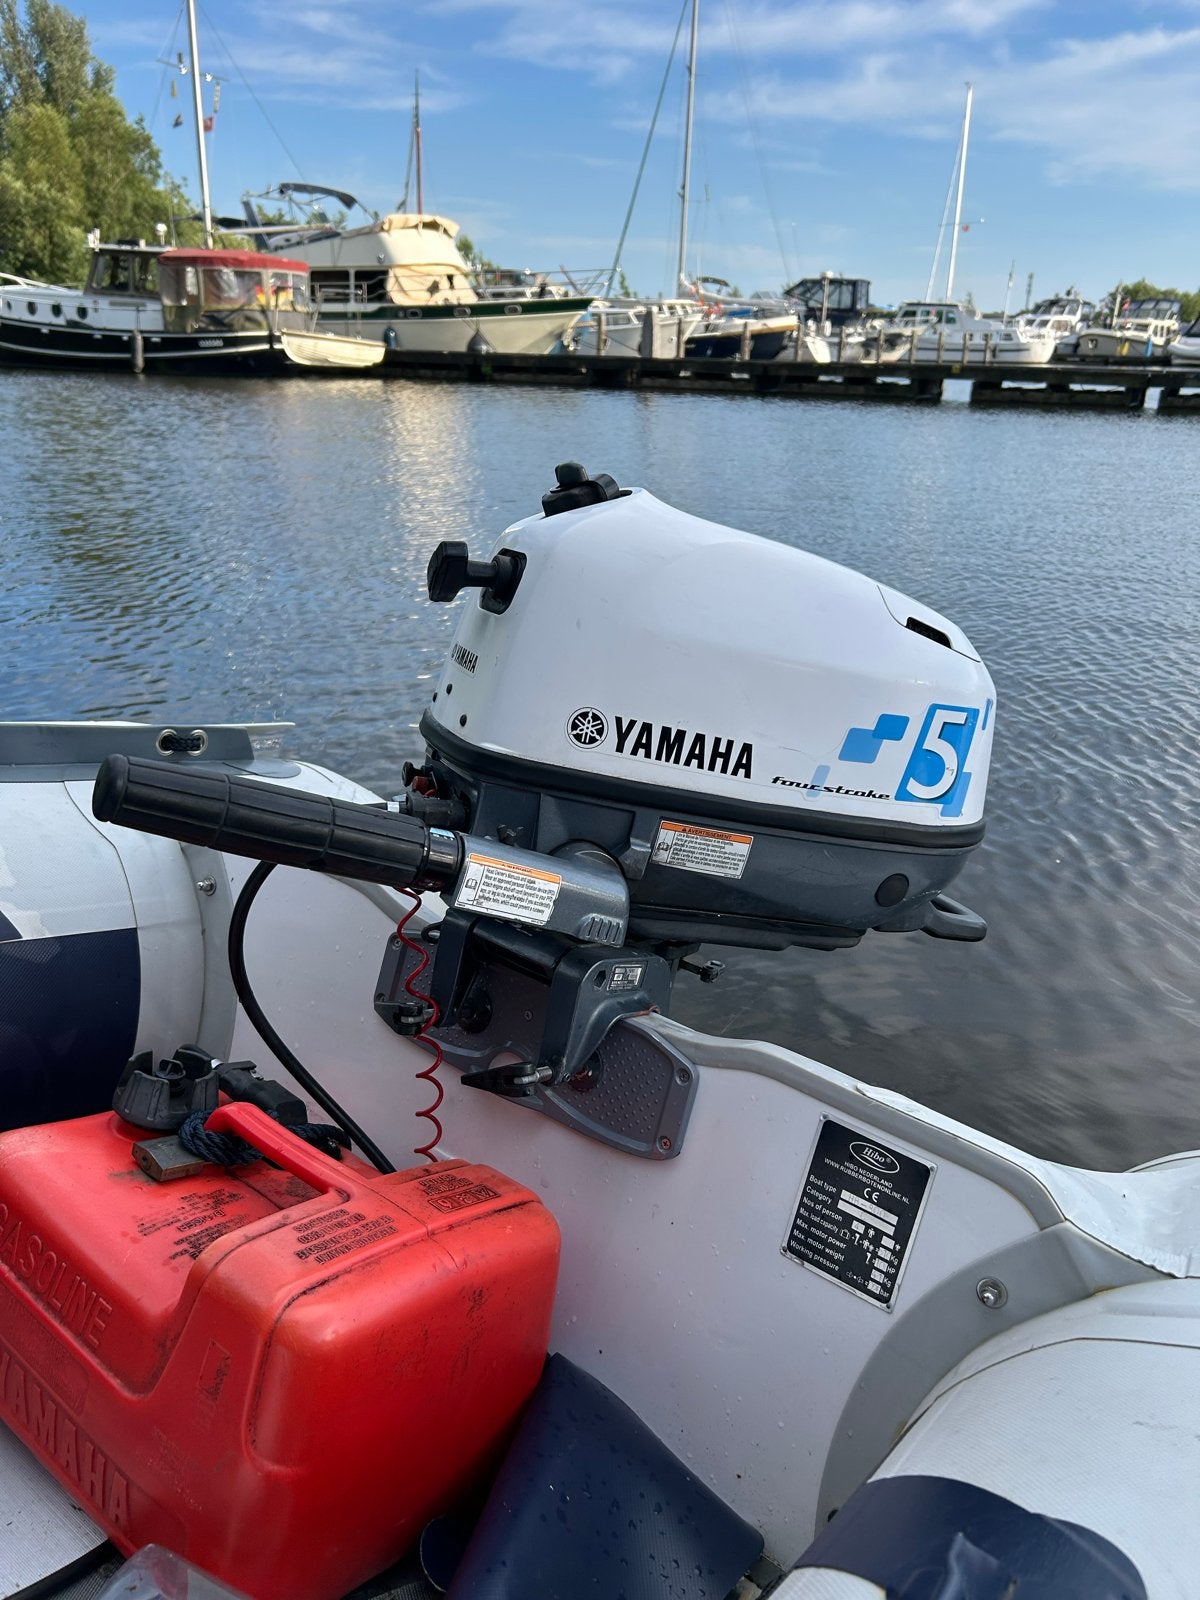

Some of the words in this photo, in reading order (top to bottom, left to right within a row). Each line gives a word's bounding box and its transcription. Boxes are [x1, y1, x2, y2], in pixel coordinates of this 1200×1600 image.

[454, 644, 478, 673] YAMAHA
[613, 716, 753, 779] YAMAHA
[906, 709, 968, 799] 5
[862, 1145, 886, 1163] Hibo
[809, 1174, 823, 1186] Boat
[822, 1181, 837, 1195] type
[843, 1161, 858, 1171] HIBO
[858, 1167, 893, 1188] NEDERLAND
[805, 1185, 832, 1205] Category
[799, 1207, 809, 1217] Max.
[809, 1212, 820, 1223] load
[819, 1218, 838, 1234] capacity
[802, 1196, 815, 1207] Nos
[814, 1202, 823, 1212] of
[822, 1207, 842, 1223] person
[792, 1228, 806, 1240] Max.
[806, 1236, 825, 1251] motor
[824, 1246, 844, 1263] weight
[795, 1217, 809, 1229] Max.
[809, 1225, 828, 1239] motor
[827, 1235, 846, 1251] power
[789, 1239, 814, 1258] Working
[813, 1253, 839, 1272] pressure
[889, 1255, 898, 1266] Kg
[882, 1277, 892, 1288] Kg
[886, 1265, 895, 1275] HP
[879, 1288, 890, 1298] bar
